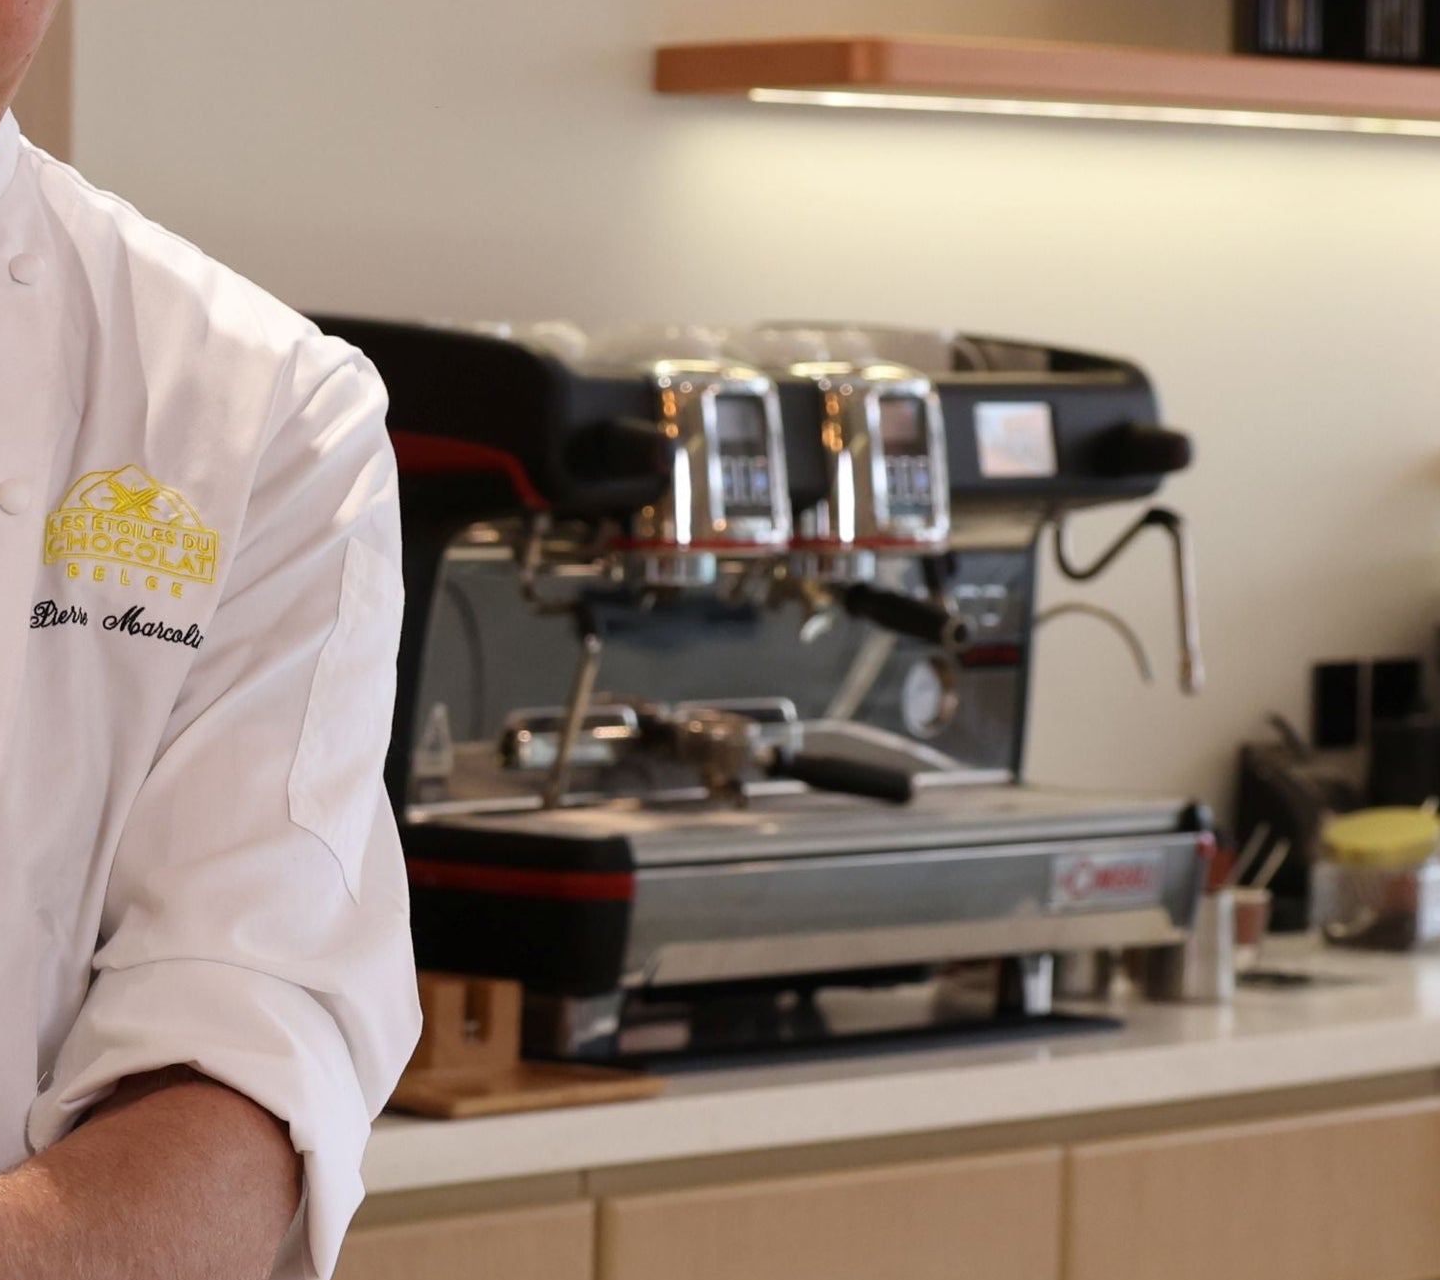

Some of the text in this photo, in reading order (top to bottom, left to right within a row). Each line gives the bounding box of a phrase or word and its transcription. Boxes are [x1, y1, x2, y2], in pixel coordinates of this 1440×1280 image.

[46, 532, 214, 576] CHOCOLAT
[49, 513, 211, 554] LES ÉTOILES DU
[67, 562, 184, 598] BELGE
